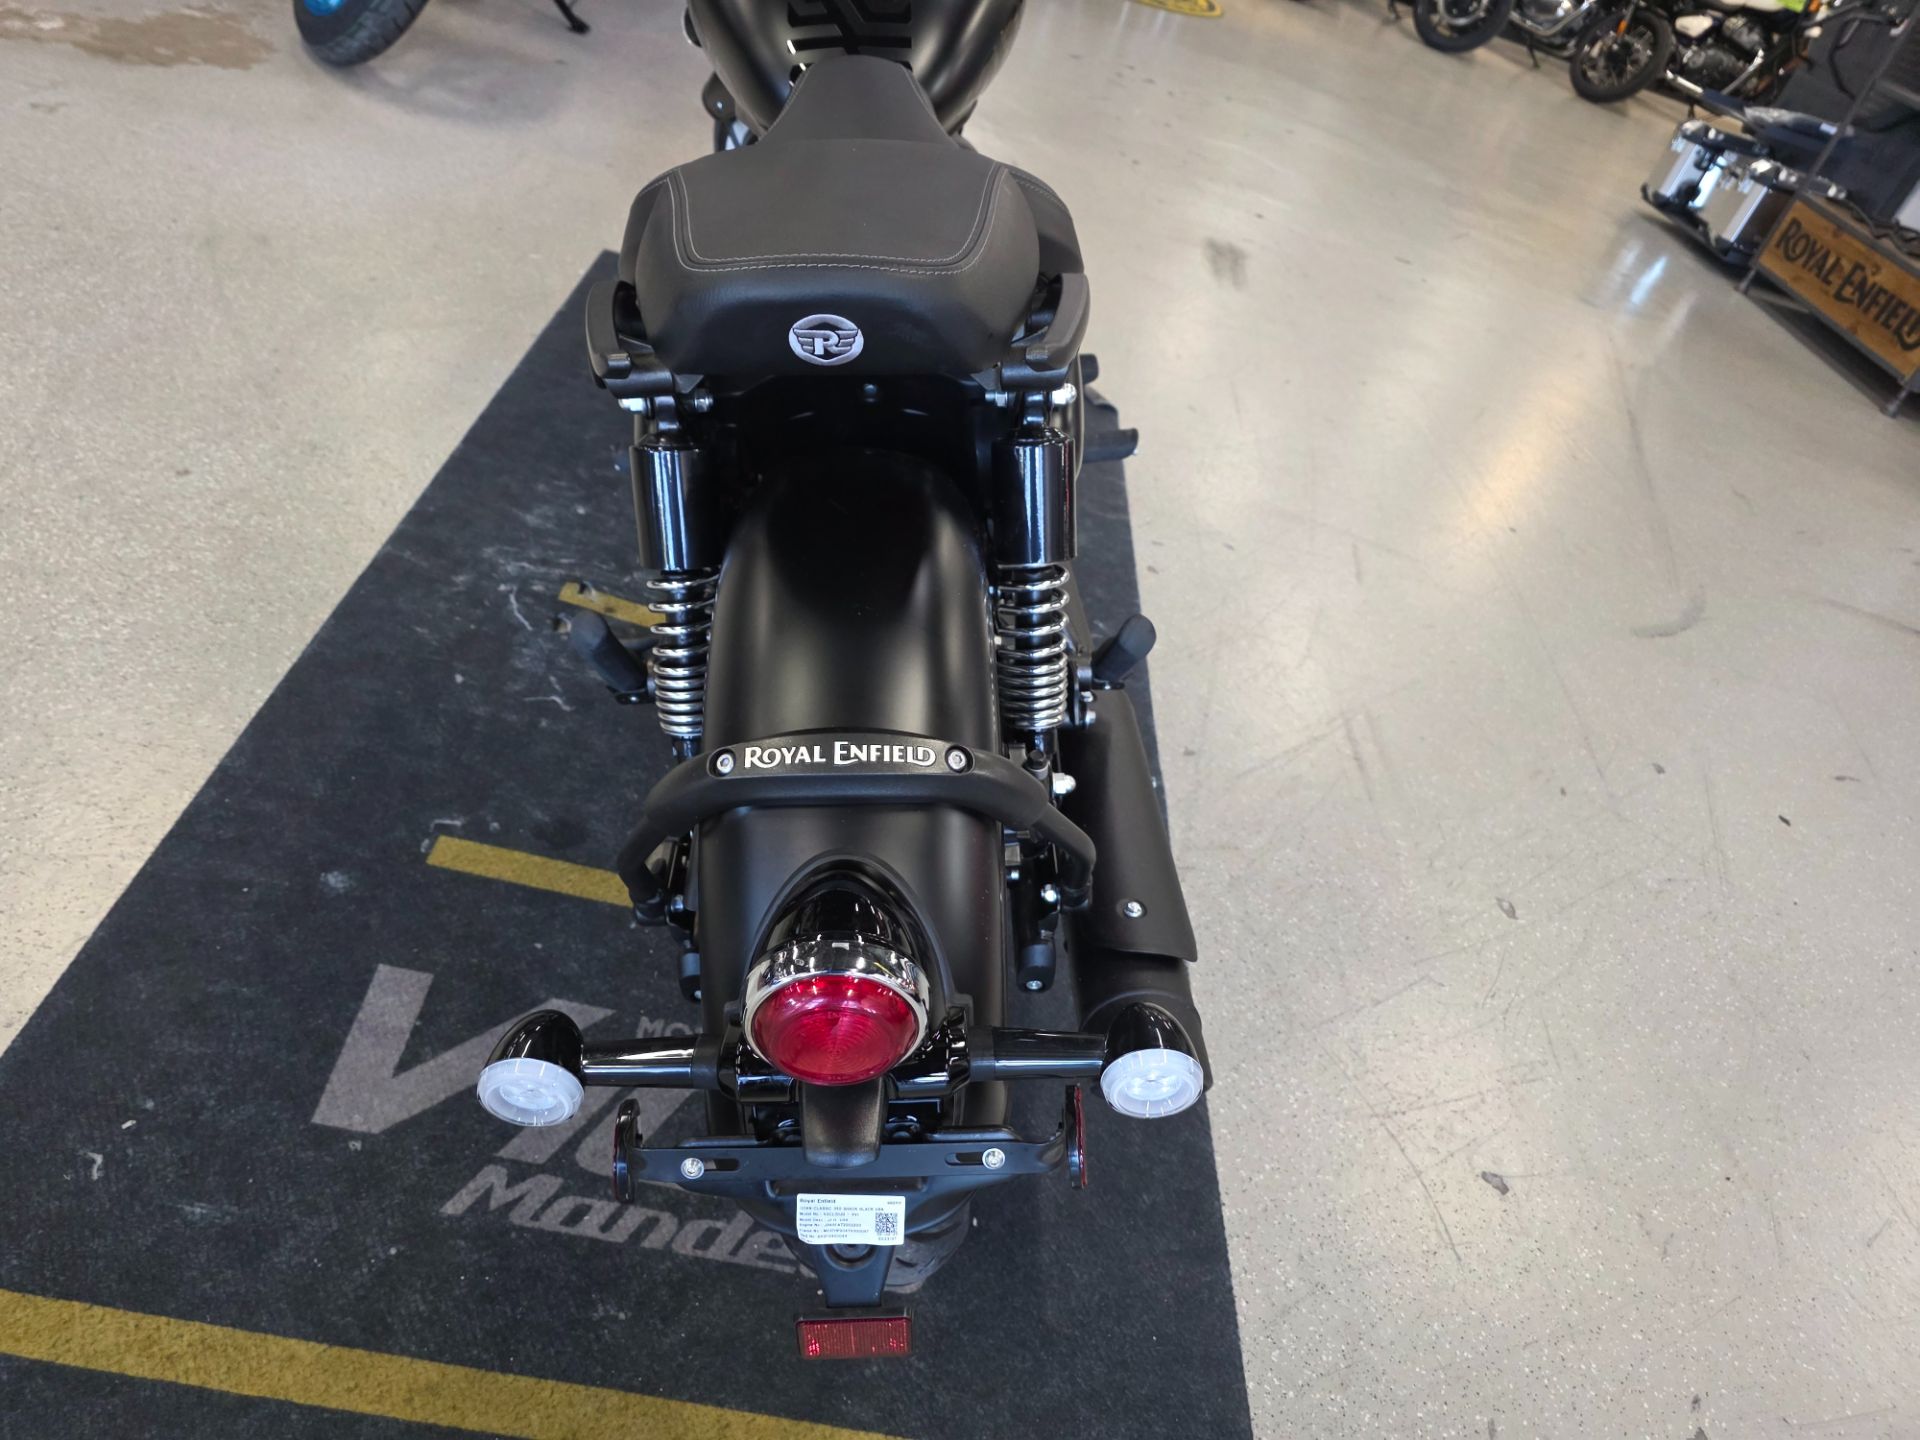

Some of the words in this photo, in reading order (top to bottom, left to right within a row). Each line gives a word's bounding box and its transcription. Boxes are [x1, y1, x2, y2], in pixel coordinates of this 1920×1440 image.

[1775, 217, 1841, 285] ROYAL
[744, 746, 826, 769] ROYAL
[833, 741, 937, 768] ENFIELD
